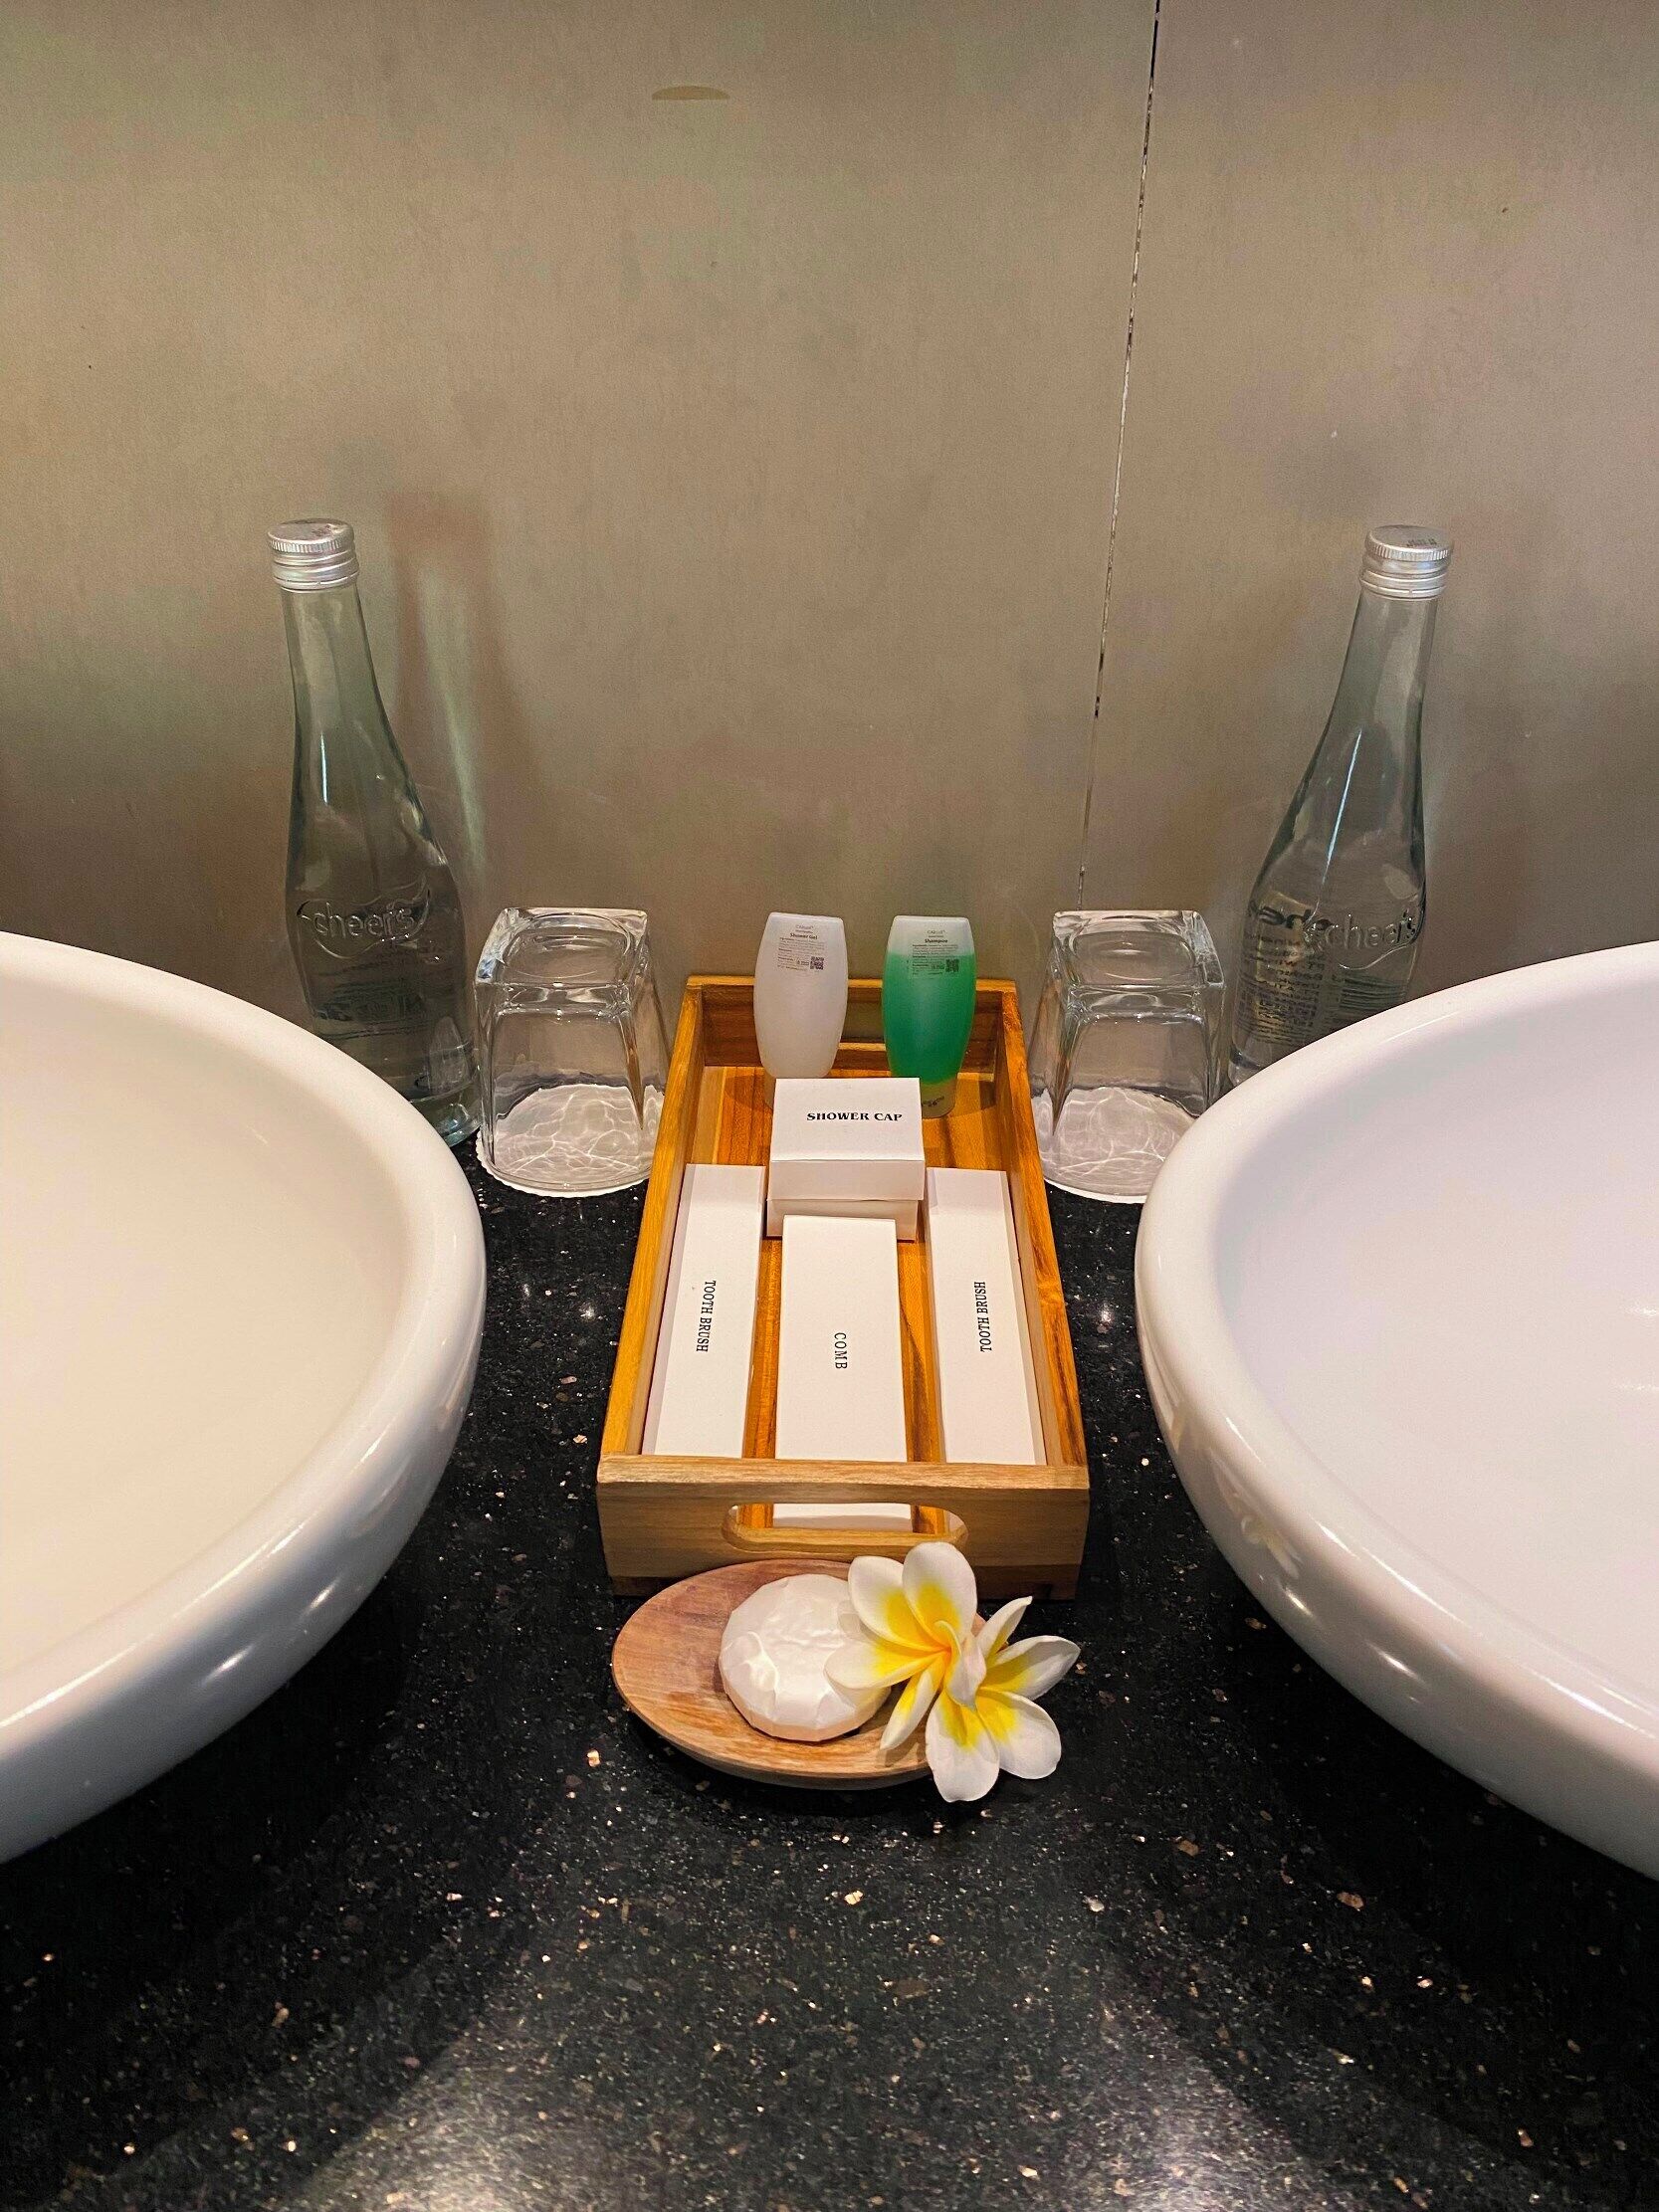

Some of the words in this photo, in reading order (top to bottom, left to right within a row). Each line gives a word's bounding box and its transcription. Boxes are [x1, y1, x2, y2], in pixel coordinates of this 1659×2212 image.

[806, 1111, 870, 1121] SHOWER
[874, 1112, 903, 1121] CAP
[701, 1281, 717, 1314] TOOTH
[974, 1282, 988, 1314] BRUSH
[696, 1317, 712, 1352] BRUSH
[834, 1332, 848, 1369] COMB
[977, 1316, 992, 1352] TOOTH
